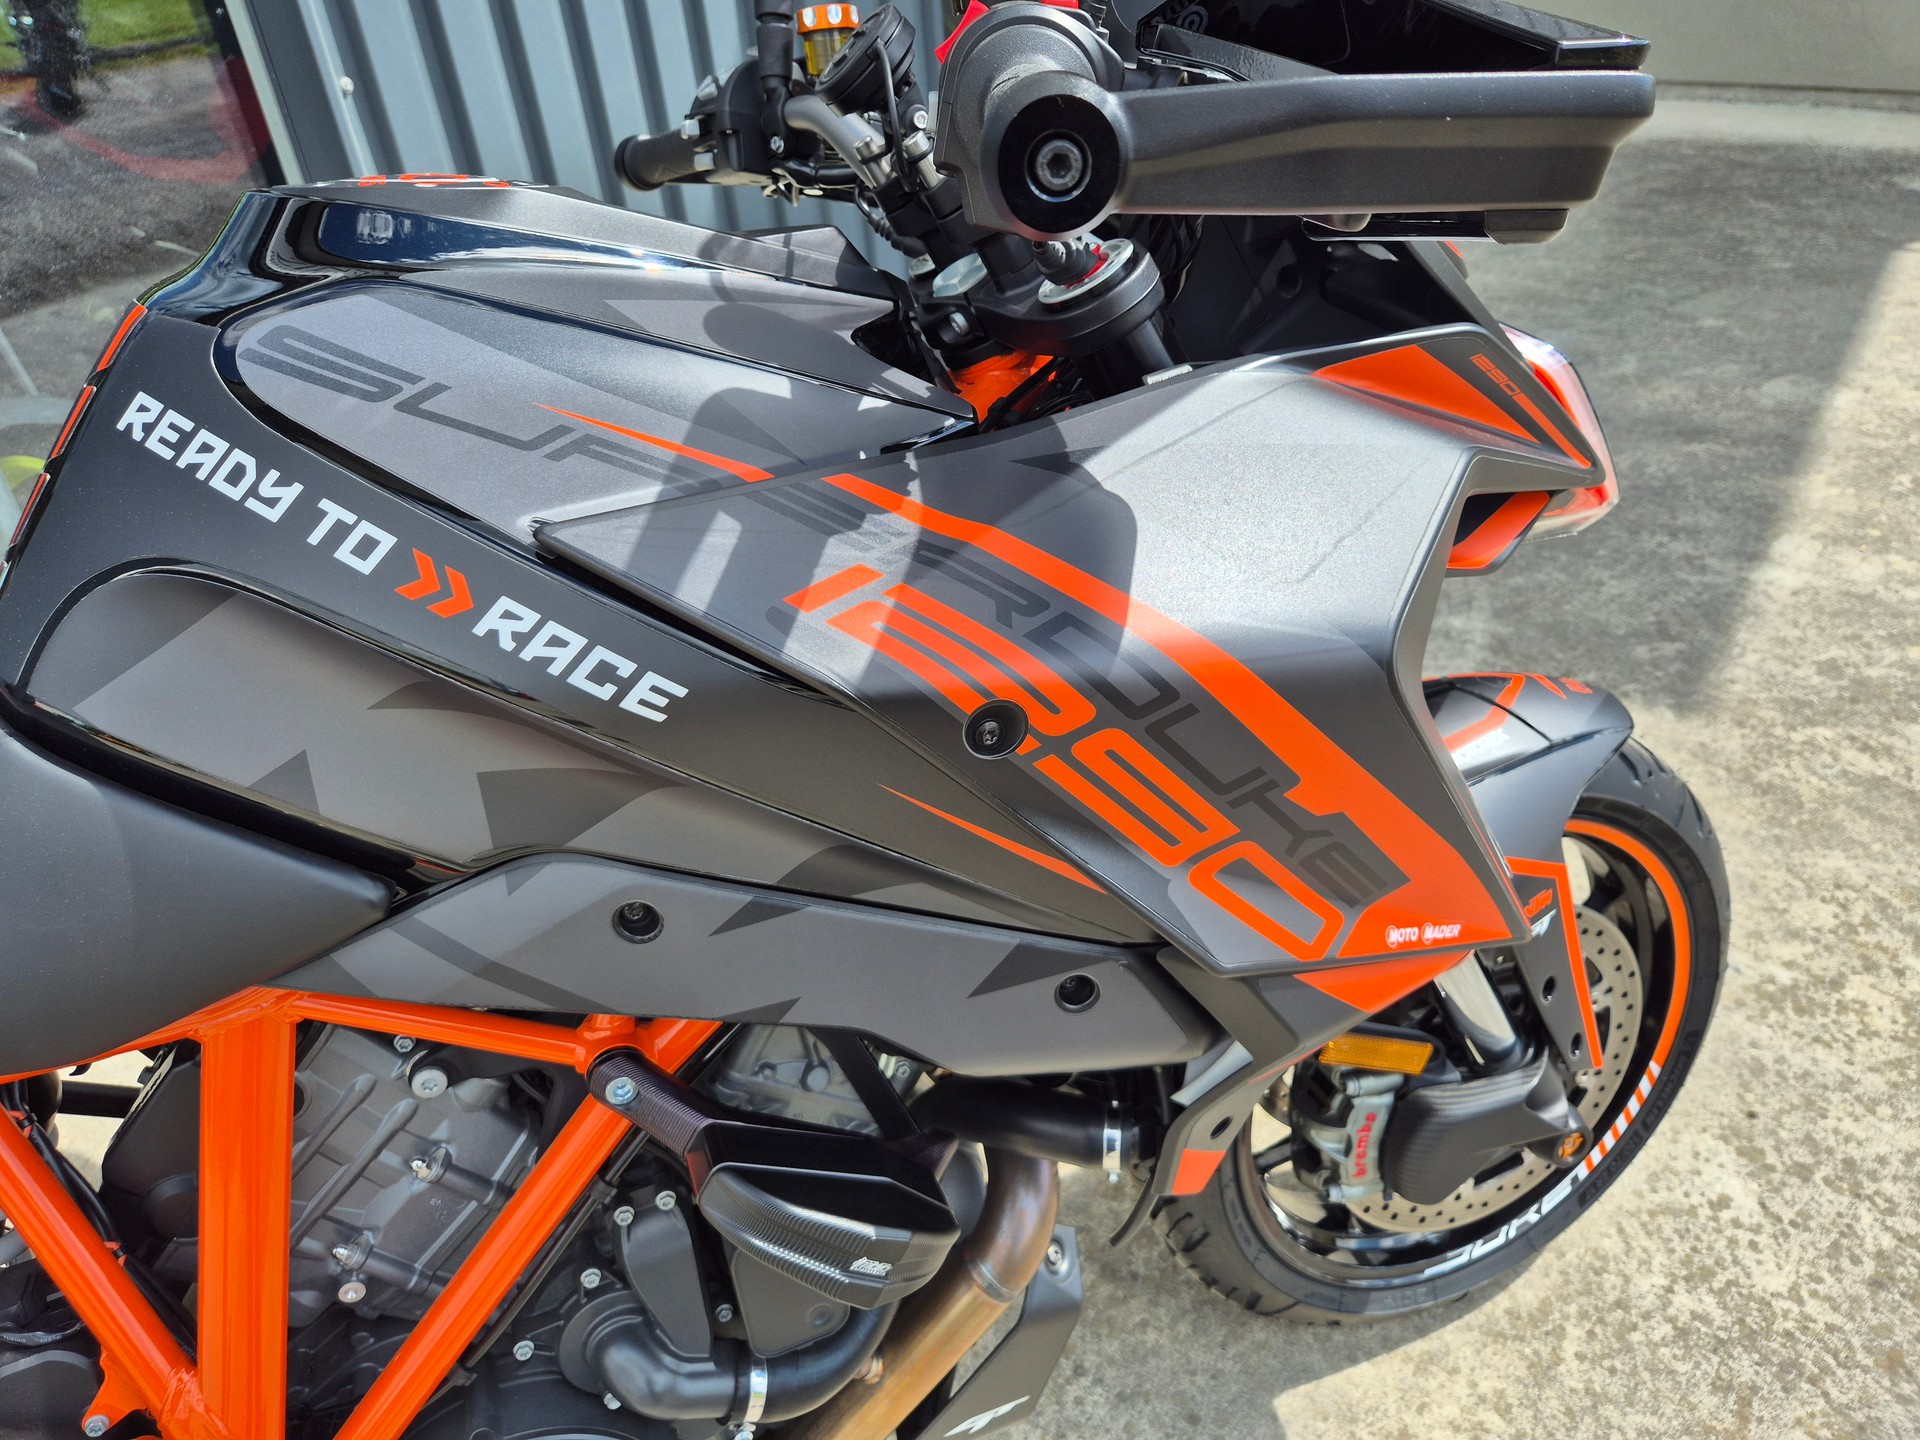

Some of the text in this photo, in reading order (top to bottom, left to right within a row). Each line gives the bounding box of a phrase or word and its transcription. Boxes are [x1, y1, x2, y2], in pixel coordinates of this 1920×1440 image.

[1469, 353, 1522, 397] 1290
[116, 391, 689, 722] READY TO RACE
[783, 564, 1345, 962] 1290
[1385, 922, 1462, 949] MOTO MADER
[1351, 1112, 1377, 1179] brembo
